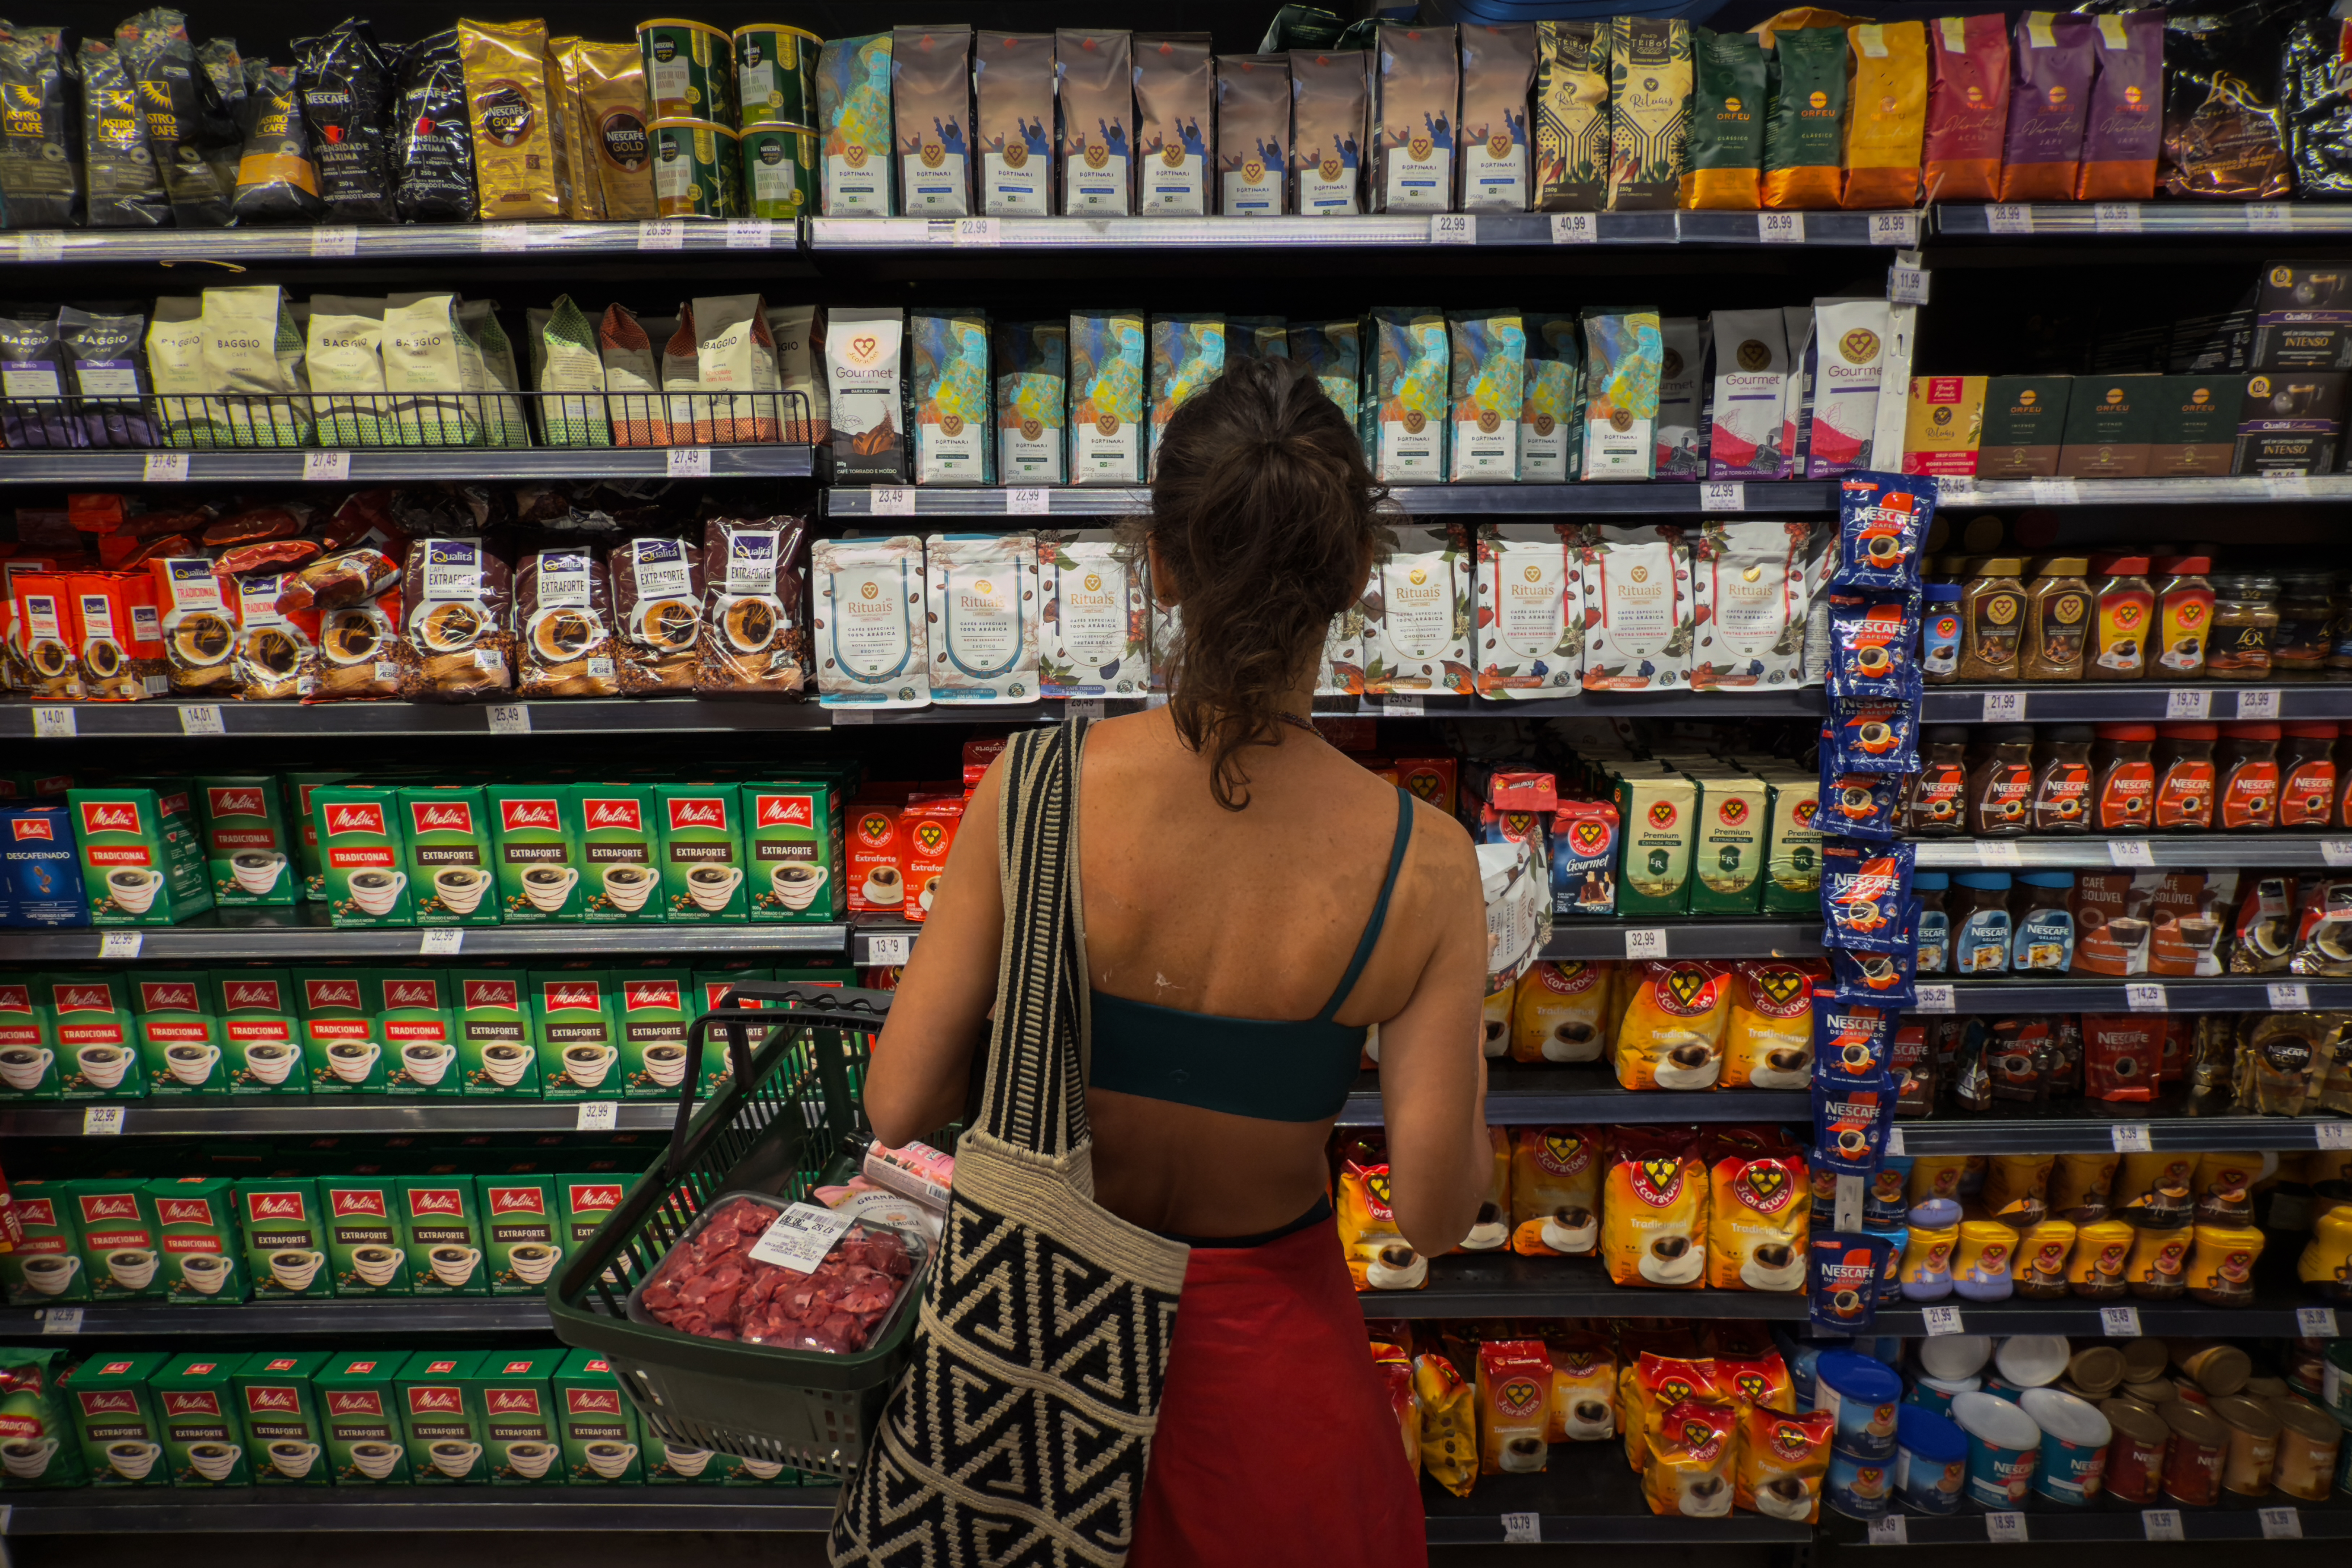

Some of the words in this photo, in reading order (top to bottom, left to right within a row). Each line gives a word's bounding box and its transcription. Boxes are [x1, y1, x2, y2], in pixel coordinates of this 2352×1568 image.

[1630, 93, 1673, 108] Rituais
[5, 111, 41, 121] ASTRO
[1717, 113, 1750, 121] ORFEU
[1801, 109, 1835, 118] ORFEU
[102, 119, 135, 129] ASTRO
[606, 129, 645, 142] NESCAFÉ
[612, 142, 643, 153] GOLD
[1441, 217, 1465, 233] 22,99
[1560, 216, 1585, 233] 40,99
[1767, 216, 1792, 231] 28,99
[1879, 217, 1904, 232] 28,99
[218, 340, 260, 349] BAGGIO
[323, 338, 367, 348] BAGGIO
[396, 337, 441, 347] BAGGIO
[703, 336, 737, 350] BAGGIO
[2285, 338, 2328, 346] INTENSO
[836, 367, 893, 379] Gourmet
[1828, 366, 1883, 378] Gourme
[1726, 375, 1780, 386] Gourmet
[2264, 446, 2307, 454] INTENSO
[313, 454, 337, 468] 27,49
[674, 451, 699, 467] 27,49
[1016, 489, 1039, 505] 22,99
[1710, 484, 1734, 500] 22,99
[878, 491, 903, 507] 23,49
[433, 550, 473, 562] Qualitá
[640, 548, 678, 562] Qualitá
[541, 581, 584, 593] EXTRAFORTE
[177, 588, 217, 599] TRADICIONAL
[1070, 593, 1114, 605] Rituais
[848, 601, 893, 614] Rituais
[960, 595, 1006, 608] Rituais
[1991, 695, 2014, 709] 21,99
[494, 708, 519, 723] 25,49
[1921, 781, 1963, 792] NESCAFÉ
[2048, 780, 2089, 791] NESCAFÉ
[91, 808, 132, 827] Melitta
[334, 808, 375, 827] Melitta
[7, 852, 70, 860] DESCAFEINADO
[334, 853, 389, 862] TRADICIONAL
[423, 851, 473, 860] EXTRAFORTE
[510, 849, 561, 858] EXTRAFORTE
[1566, 855, 1610, 872] Gourmet
[2027, 923, 2069, 936] NESCAFÉ
[1632, 932, 1655, 949] 32,99
[552, 987, 593, 1004] Melitta
[634, 984, 672, 1003] Melitta
[1827, 1014, 1886, 1031] NESCAFÉ
[64, 1030, 117, 1038] TRADICIONAL
[471, 1027, 519, 1036] EXTRAFORTE
[552, 1028, 601, 1037] EXTRAFORTE
[586, 1104, 608, 1119] 32,99
[339, 1194, 379, 1210] Melitta
[497, 1192, 536, 1208] Melitta
[93, 1235, 145, 1244] TRADICIONAL
[341, 1231, 388, 1240] EXTRAFORTE
[418, 1231, 464, 1239] EXTRAFORTE
[416, 1392, 454, 1407] Melitta
